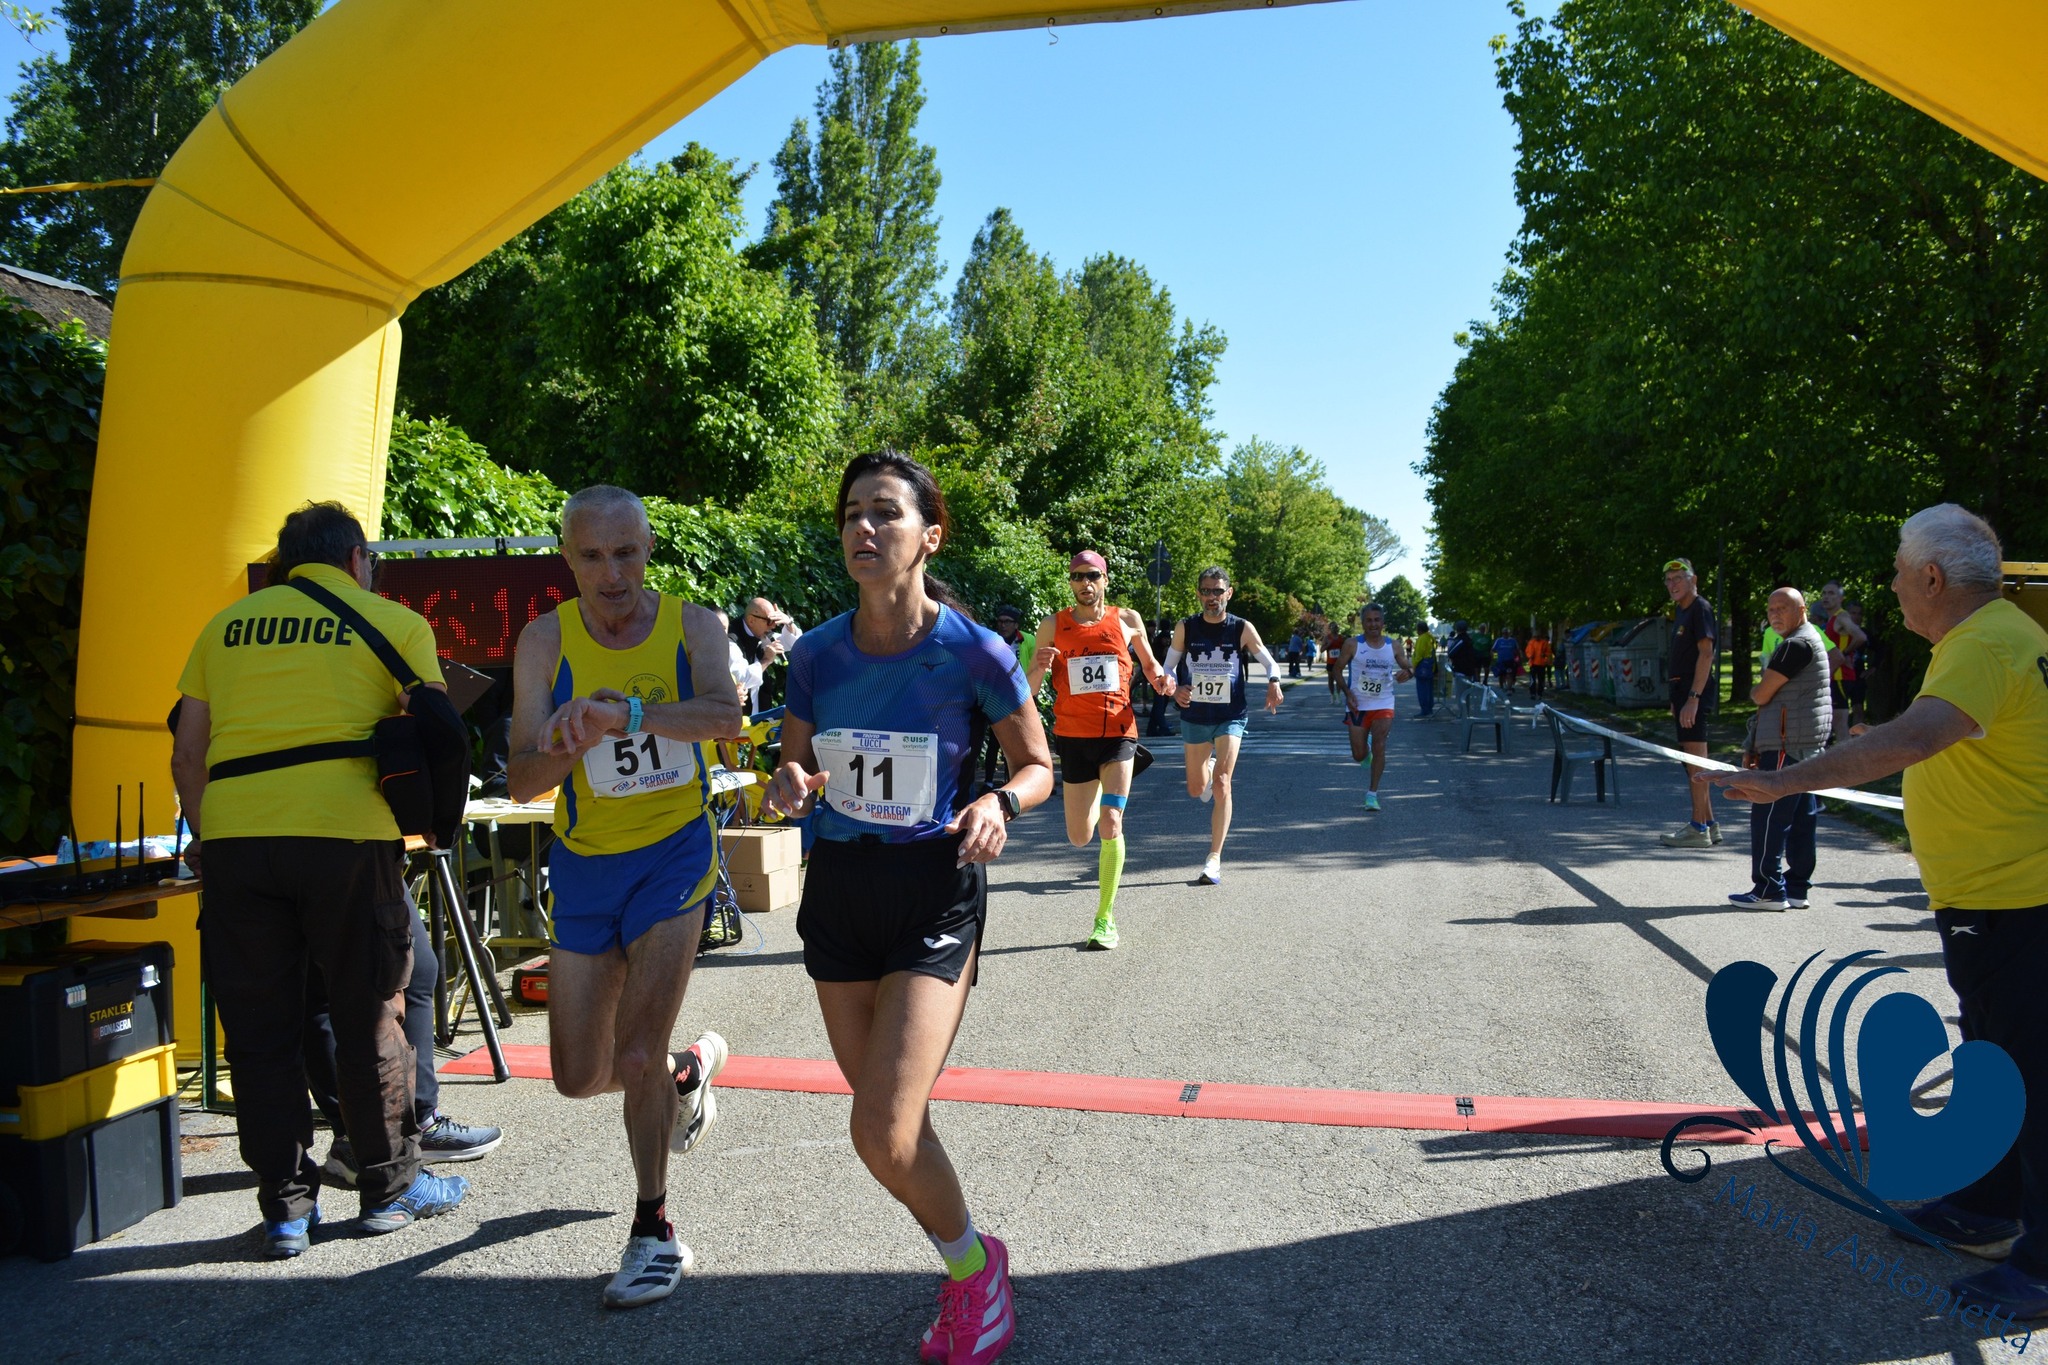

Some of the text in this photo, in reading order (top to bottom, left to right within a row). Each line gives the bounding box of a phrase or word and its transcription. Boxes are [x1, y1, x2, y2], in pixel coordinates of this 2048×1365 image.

[223, 616, 353, 648] GIUDICE
[1082, 665, 1106, 683] 84
[1197, 681, 1223, 696] 197
[1362, 681, 1382, 693] 328
[860, 739, 882, 748] LUCCI
[614, 733, 662, 776] 51
[639, 770, 679, 785] SPORTGM
[849, 754, 893, 801] 11
[865, 803, 911, 816] SPORTGM
[89, 1001, 134, 1023] STANLEY
